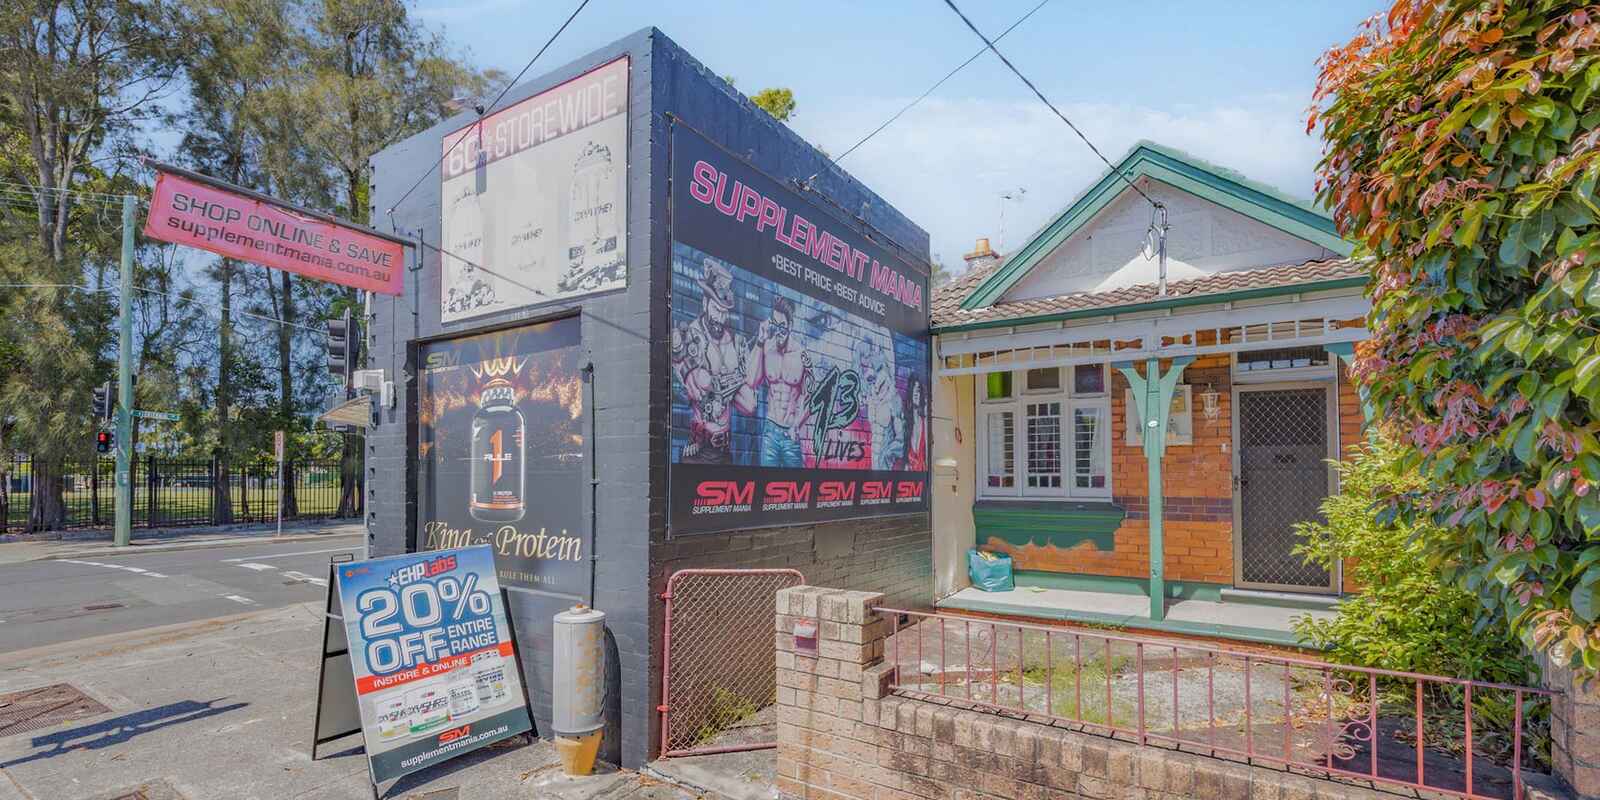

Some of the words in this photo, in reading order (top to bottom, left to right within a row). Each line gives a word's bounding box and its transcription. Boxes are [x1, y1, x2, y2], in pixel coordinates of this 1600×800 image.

[495, 75, 618, 157] STOREWIDE
[172, 194, 241, 224] SHOP
[247, 214, 324, 250] ONLINE
[328, 239, 341, 254] &
[347, 243, 393, 268] SAVE
[690, 160, 869, 283] SUPPLEMENT
[869, 258, 922, 313] MANIA
[167, 216, 392, 283] supplementmania.com.au
[804, 268, 832, 293] PRICE
[858, 288, 886, 317] ADVICE
[696, 480, 756, 505] SM
[765, 480, 811, 503] SM
[818, 480, 856, 501] SM
[862, 480, 893, 499] SM
[896, 480, 923, 497] SM
[692, 505, 733, 514] SUPPLEMENT
[424, 521, 472, 549] King
[496, 525, 582, 562] Protein
[519, 572, 541, 583] THEM
[359, 574, 491, 638] 20%
[369, 627, 447, 673] OFF
[448, 617, 494, 638] ENTIRE
[451, 632, 496, 653] RANGE
[374, 670, 420, 689] INSTORE
[422, 667, 430, 676] &
[432, 657, 469, 673] ONLINE
[401, 725, 509, 769] supplementmania.com.au
[439, 725, 472, 741] SM
